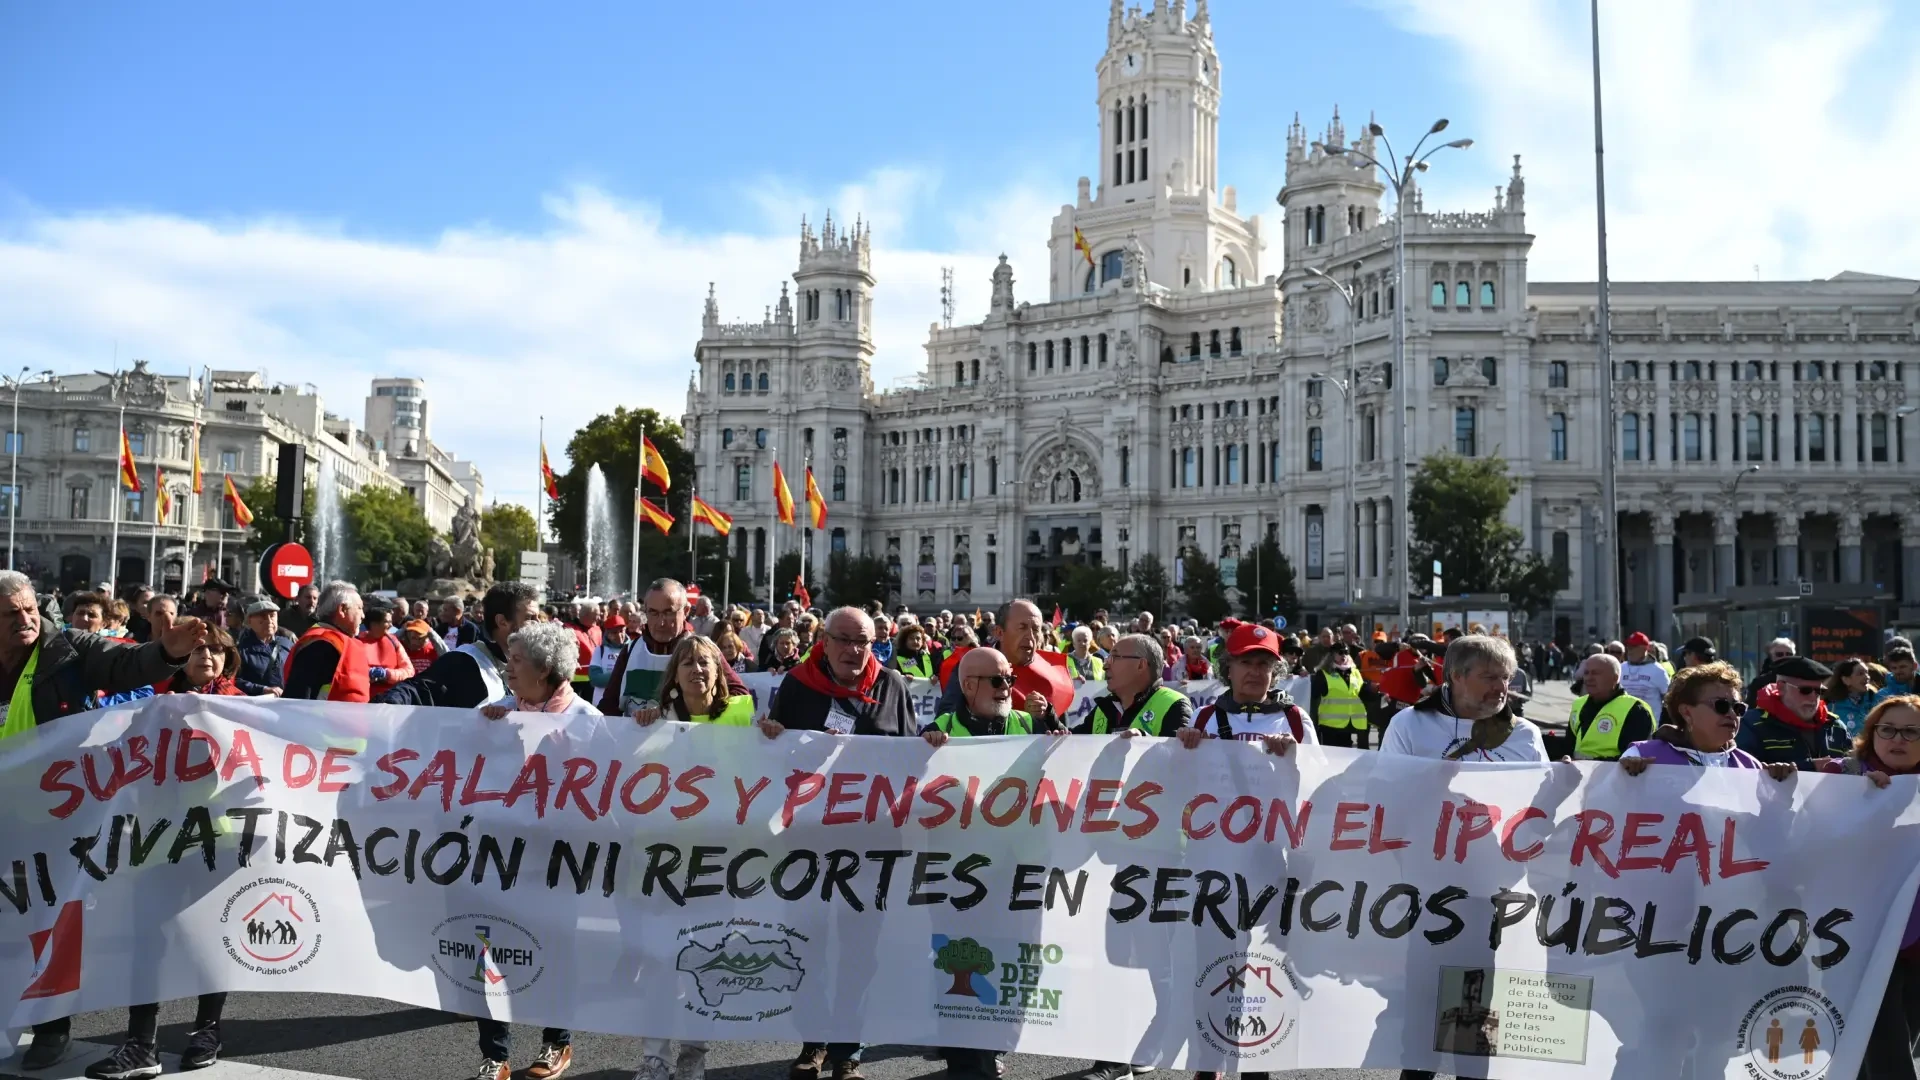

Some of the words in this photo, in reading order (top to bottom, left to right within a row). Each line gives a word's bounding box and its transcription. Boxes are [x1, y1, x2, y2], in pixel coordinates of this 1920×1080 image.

[40, 728, 266, 820] SUBIDA
[283, 743, 356, 793] DE
[371, 747, 716, 821] SALARIOS
[733, 774, 771, 826] Y
[781, 769, 1164, 841] PENSIONES
[1183, 793, 1312, 851] CON
[1330, 802, 1412, 854] EL
[1433, 799, 1548, 864] IPC
[1570, 809, 1770, 885] REAL
[220, 880, 258, 923] Coordinadora
[258, 876, 285, 886] Estatal
[285, 880, 299, 890] por
[299, 886, 306, 896] la
[304, 892, 321, 923] Defensa
[547, 839, 622, 898] NI
[642, 842, 991, 913] RECORTES
[1009, 863, 1089, 917] EN
[1109, 864, 1469, 946] SERVICIOS
[1489, 881, 1854, 970] PÚBLICOS
[777, 923, 810, 943] Defensa
[222, 936, 231, 949] del
[227, 947, 255, 972] Sistema
[255, 966, 287, 975] Público
[288, 964, 299, 973] de
[297, 933, 322, 968] Pensiones
[438, 939, 476, 961] EHPM
[492, 947, 533, 966] MPEH
[1017, 942, 1063, 964] MO
[1000, 962, 1040, 986] DE
[1195, 953, 1234, 988] Coordinadora
[1234, 951, 1262, 959] Estatal
[1261, 955, 1275, 963] por
[1274, 958, 1281, 967] la
[1280, 964, 1298, 990] Defensa
[455, 980, 463, 988] DE
[1509, 976, 1577, 990] Plataforma
[999, 985, 1063, 1011] PEN
[1226, 995, 1267, 1004] UNIDAD
[1508, 988, 1524, 997] de
[1527, 990, 1576, 1002] Badajoz
[712, 1010, 753, 1022] Pensiones
[755, 1005, 793, 1022] Públicas
[933, 1003, 974, 1012] Movemento
[974, 1006, 999, 1016] Galego
[1017, 1009, 1045, 1019] Defensa
[1045, 1011, 1059, 1019] das
[1507, 1001, 1534, 1010] para
[1538, 1001, 1548, 1010] la
[1769, 1001, 1819, 1017] PENSIONISTAS
[992, 1015, 1022, 1024] Servizos
[1506, 1010, 1555, 1022] Defensa
[1736, 998, 1766, 1050] PLATAFORMA
[1763, 985, 1822, 1001] PENSIONISTAS
[1820, 995, 1832, 1008] DE
[1505, 1021, 1521, 1030] de
[1524, 1022, 1541, 1032] las
[1201, 1031, 1228, 1055] Sistema
[1260, 1047, 1270, 1056] de
[1270, 1018, 1296, 1049] Pensiones
[1504, 1032, 1566, 1045] Pensiones
[1503, 1043, 1553, 1055] Públicas
